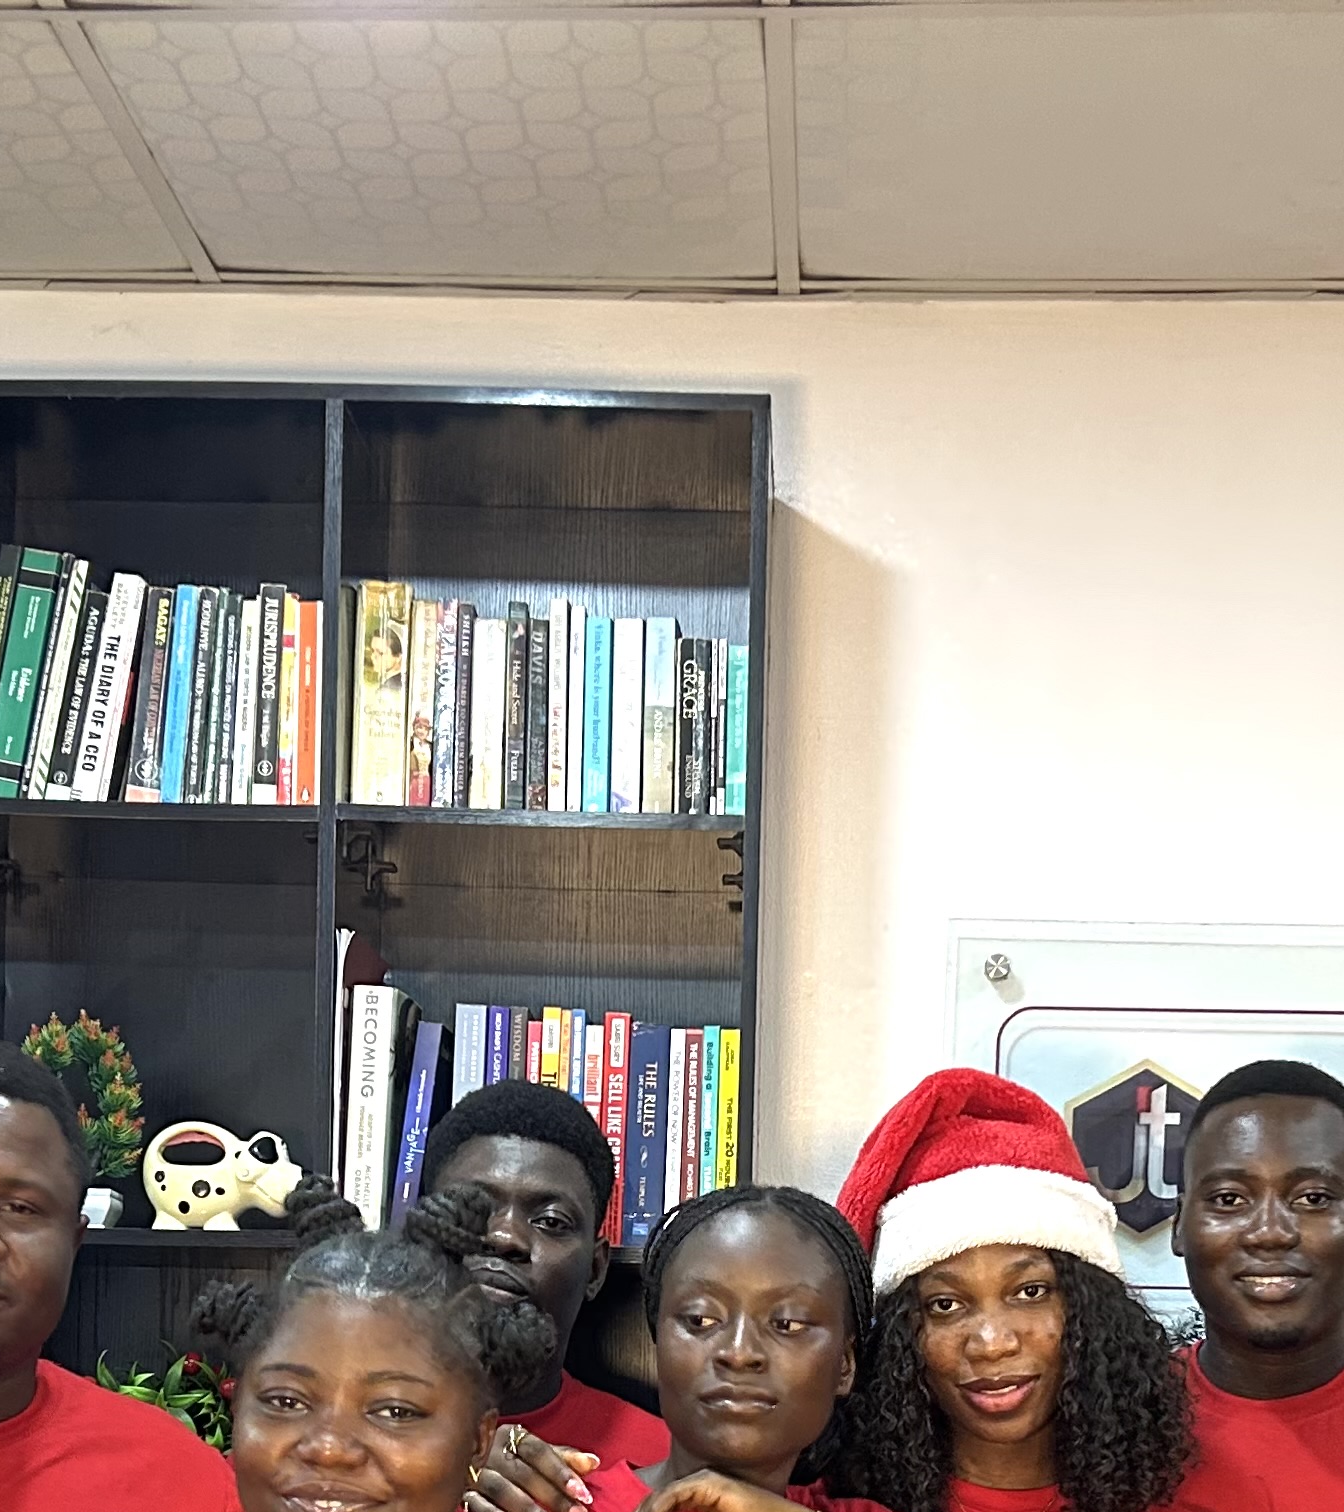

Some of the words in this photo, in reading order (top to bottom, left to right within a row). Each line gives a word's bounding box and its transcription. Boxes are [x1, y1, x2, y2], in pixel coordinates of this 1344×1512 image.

[154, 598, 169, 646] SAGAY:
[104, 635, 121, 660] THE
[262, 597, 280, 699] JURISPRUDENCE
[531, 631, 543, 685] DAVIS
[77, 658, 90, 676] THE
[512, 660, 521, 681] Hide
[16, 667, 33, 703] Evidence
[73, 677, 86, 696] LAW
[94, 665, 115, 706] DIARY
[512, 683, 520, 699] and
[683, 660, 697, 719] GRACE
[70, 697, 82, 708] OF
[591, 695, 600, 716] your
[60, 710, 79, 754] EVIDENCE
[90, 710, 106, 728] OF
[88, 731, 101, 740] A
[82, 745, 99, 771] CEO
[510, 750, 519, 781] FULLER
[685, 755, 693, 798] ENGLUND
[360, 994, 378, 1098] BECOMING
[512, 1013, 523, 1062] WISDOM
[689, 1043, 698, 1059] THE
[673, 1052, 681, 1065] THE
[688, 1060, 698, 1085] RULES
[704, 1042, 714, 1081] Building
[586, 1054, 601, 1096] brilliant
[608, 1073, 623, 1103] SELL
[644, 1061, 658, 1089] THE
[672, 1070, 681, 1102] POWER
[688, 1086, 697, 1098] OF
[726, 1097, 734, 1114] THE
[606, 1106, 622, 1135] LIKE
[642, 1094, 656, 1137] RULES
[686, 1099, 697, 1158] MANAGEMENT
[670, 1119, 679, 1145] NOW
[704, 1131, 712, 1156] Brain
[404, 1128, 425, 1174] VANTAGE
[725, 1142, 734, 1158] 20
[354, 1169, 362, 1203] OBAMA
[362, 1165, 372, 1208] MICHELLE
[638, 1176, 646, 1207] TEMPLAR
